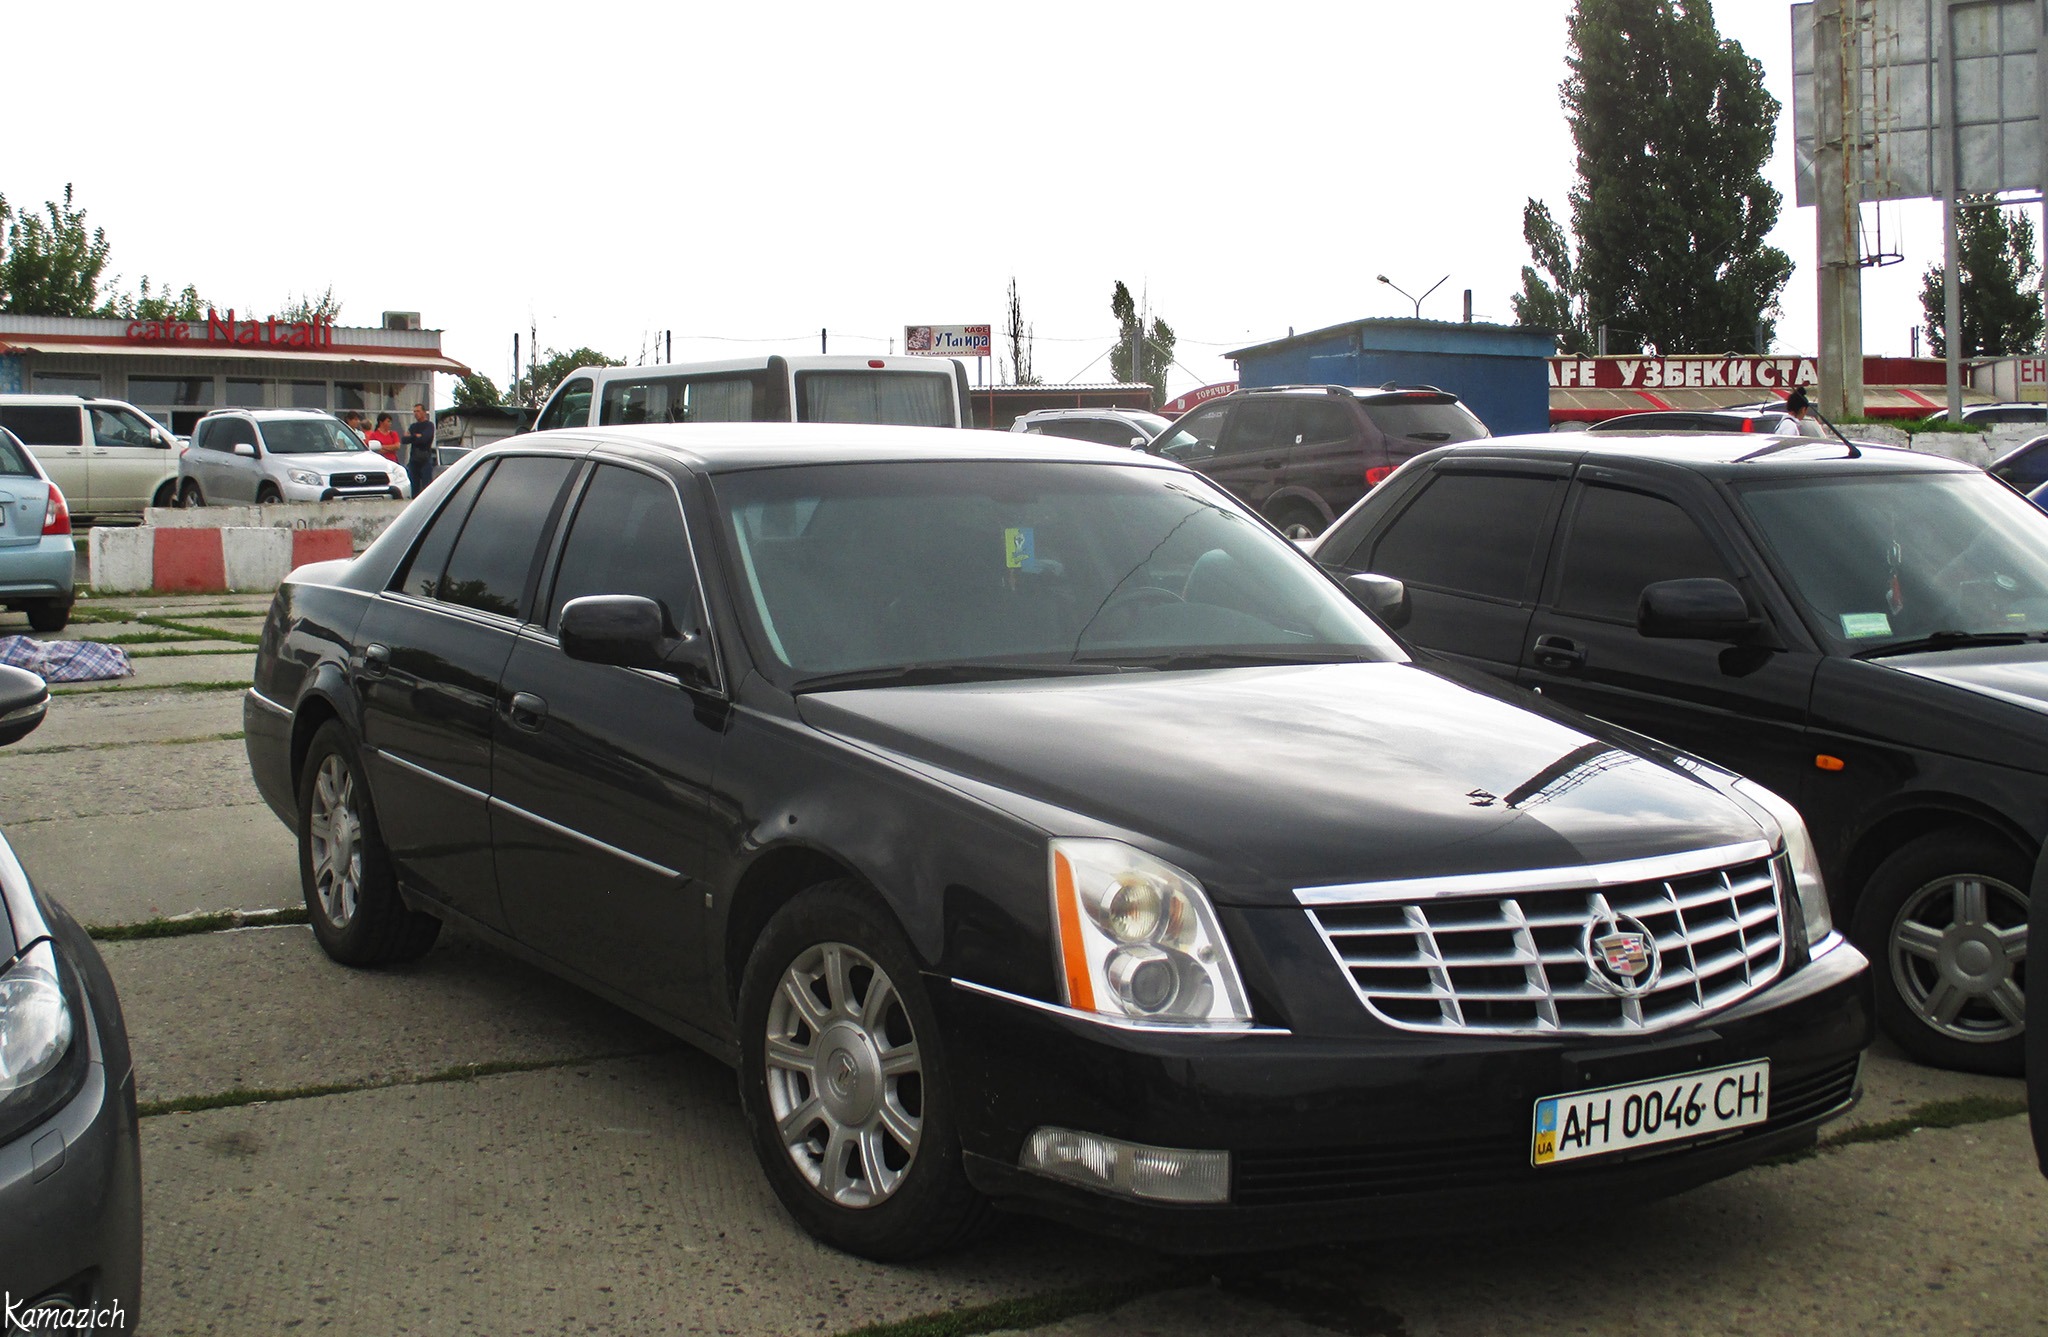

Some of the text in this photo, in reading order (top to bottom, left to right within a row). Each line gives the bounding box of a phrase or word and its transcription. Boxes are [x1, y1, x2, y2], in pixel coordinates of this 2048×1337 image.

[125, 307, 333, 348] cafe Natali
[1196, 386, 1231, 399] ГОРЯЧИЕ
[1559, 1071, 1760, 1151] AH 0046 CH
[1536, 1142, 1553, 1155] UA
